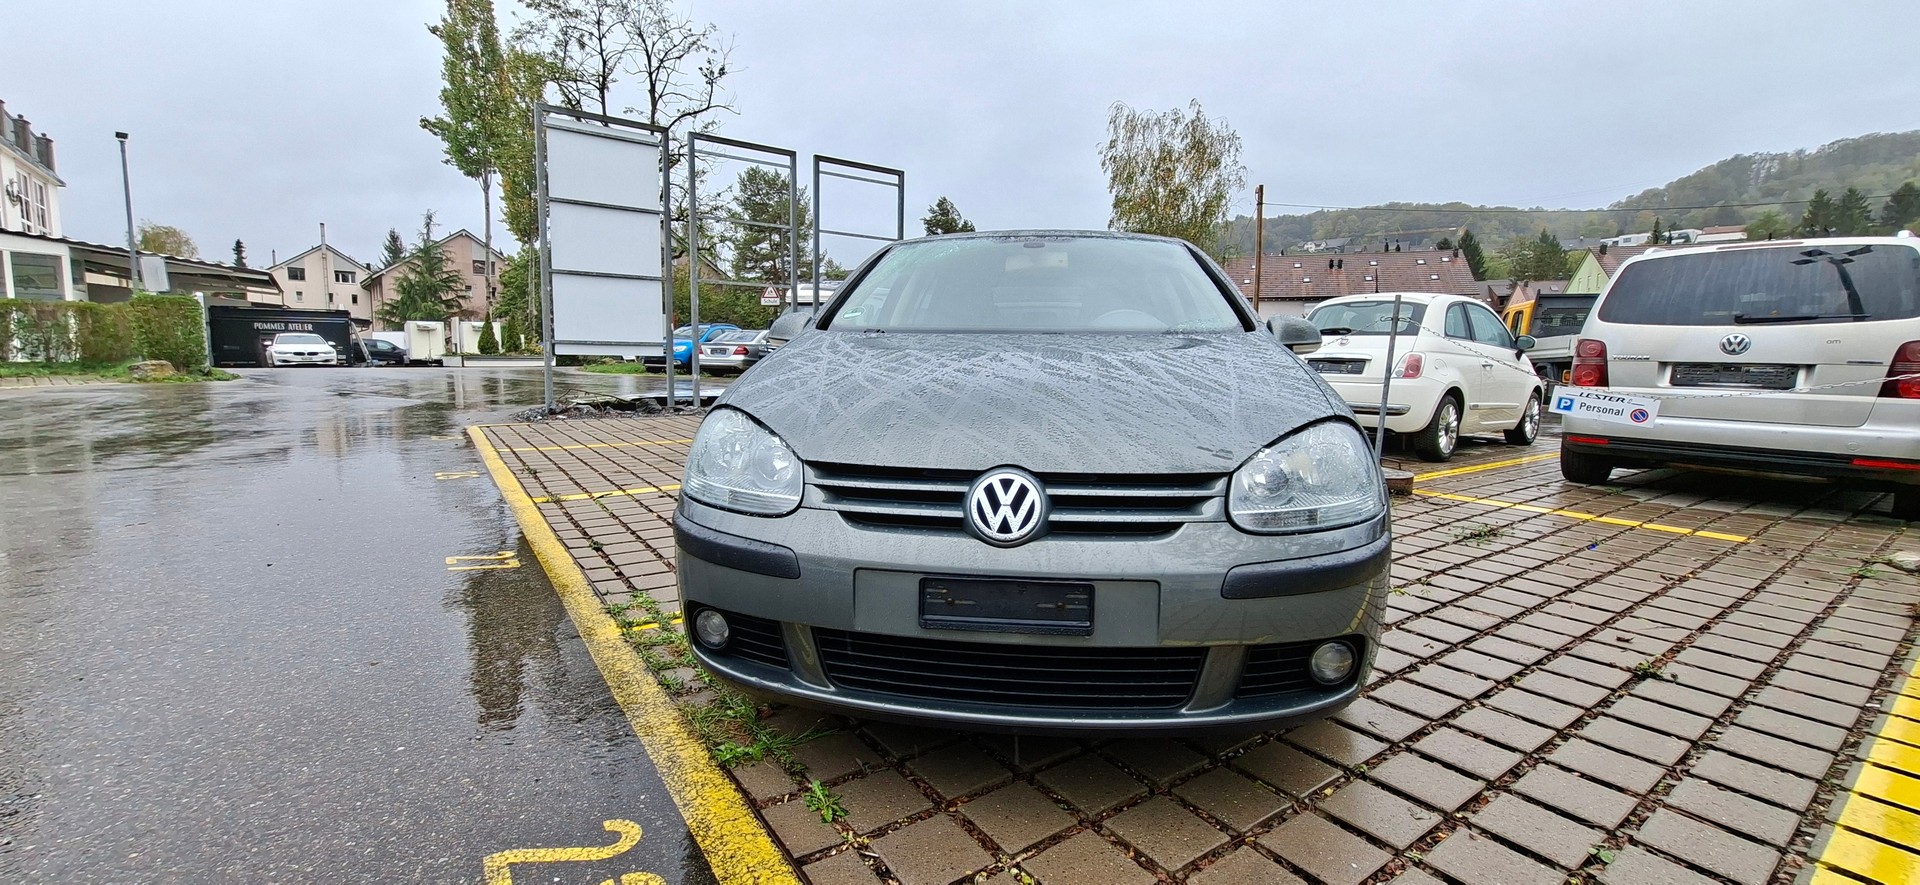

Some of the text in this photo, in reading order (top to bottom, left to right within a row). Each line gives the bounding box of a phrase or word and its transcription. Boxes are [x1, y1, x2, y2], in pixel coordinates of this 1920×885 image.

[254, 322, 314, 331] POMMES ATELIER
[1720, 333, 1751, 355] VW
[1560, 398, 1572, 409] P
[1579, 392, 1626, 404] LESTER
[1579, 402, 1625, 417] Personal
[970, 473, 1041, 541] VW
